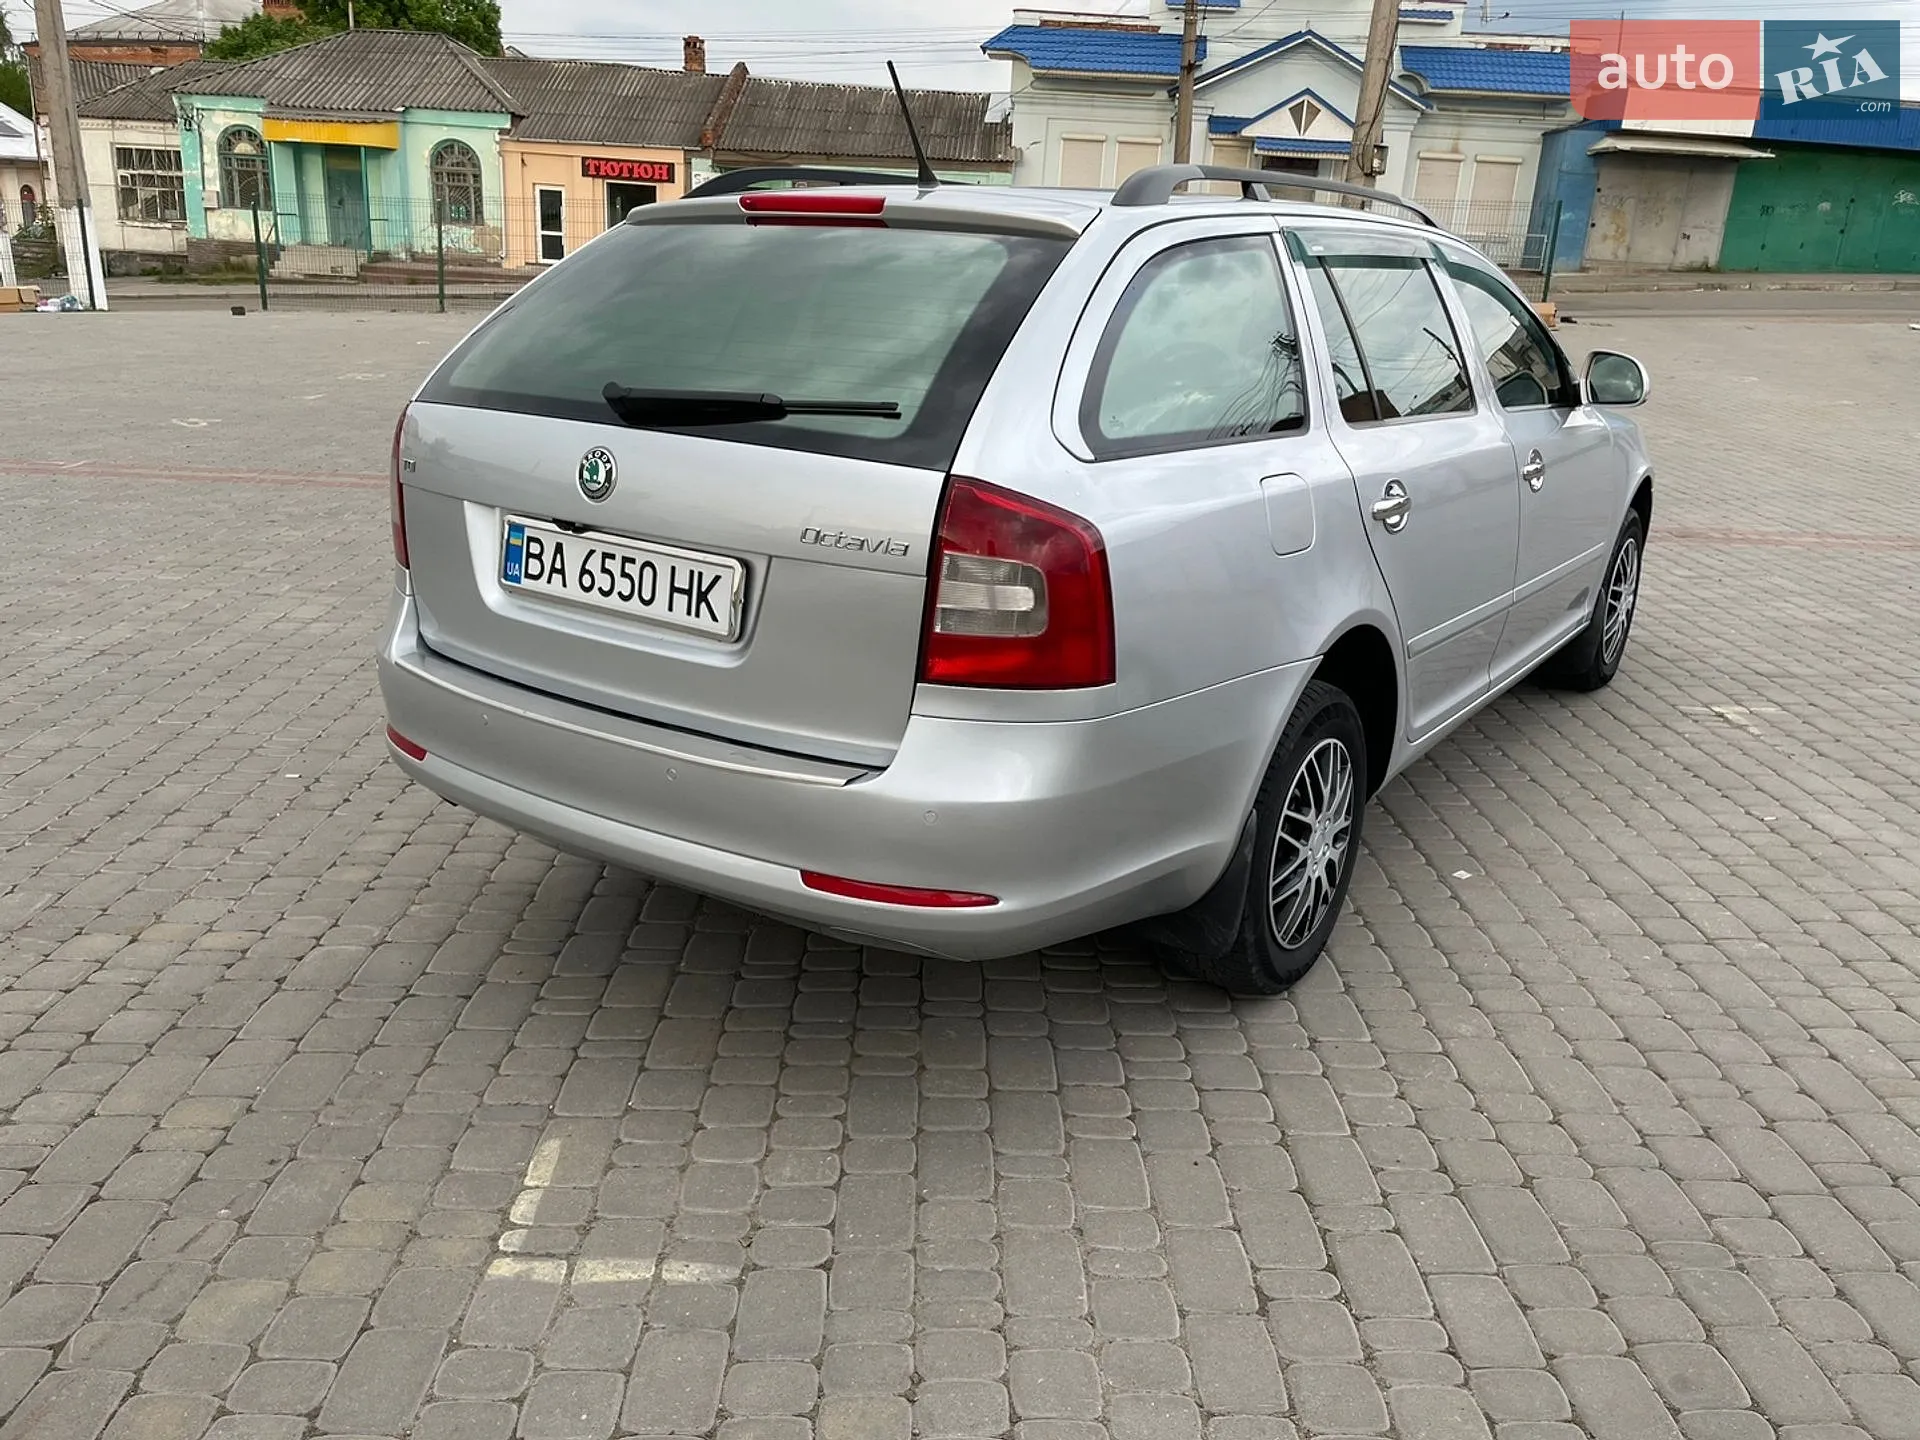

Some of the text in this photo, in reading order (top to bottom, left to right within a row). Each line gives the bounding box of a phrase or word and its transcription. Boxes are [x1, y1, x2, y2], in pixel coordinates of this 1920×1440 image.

[585, 159, 669, 180] ТЮТЮН
[800, 526, 910, 557] Octavia
[507, 562, 520, 577] UA
[524, 535, 722, 623] BA 6550 HK
